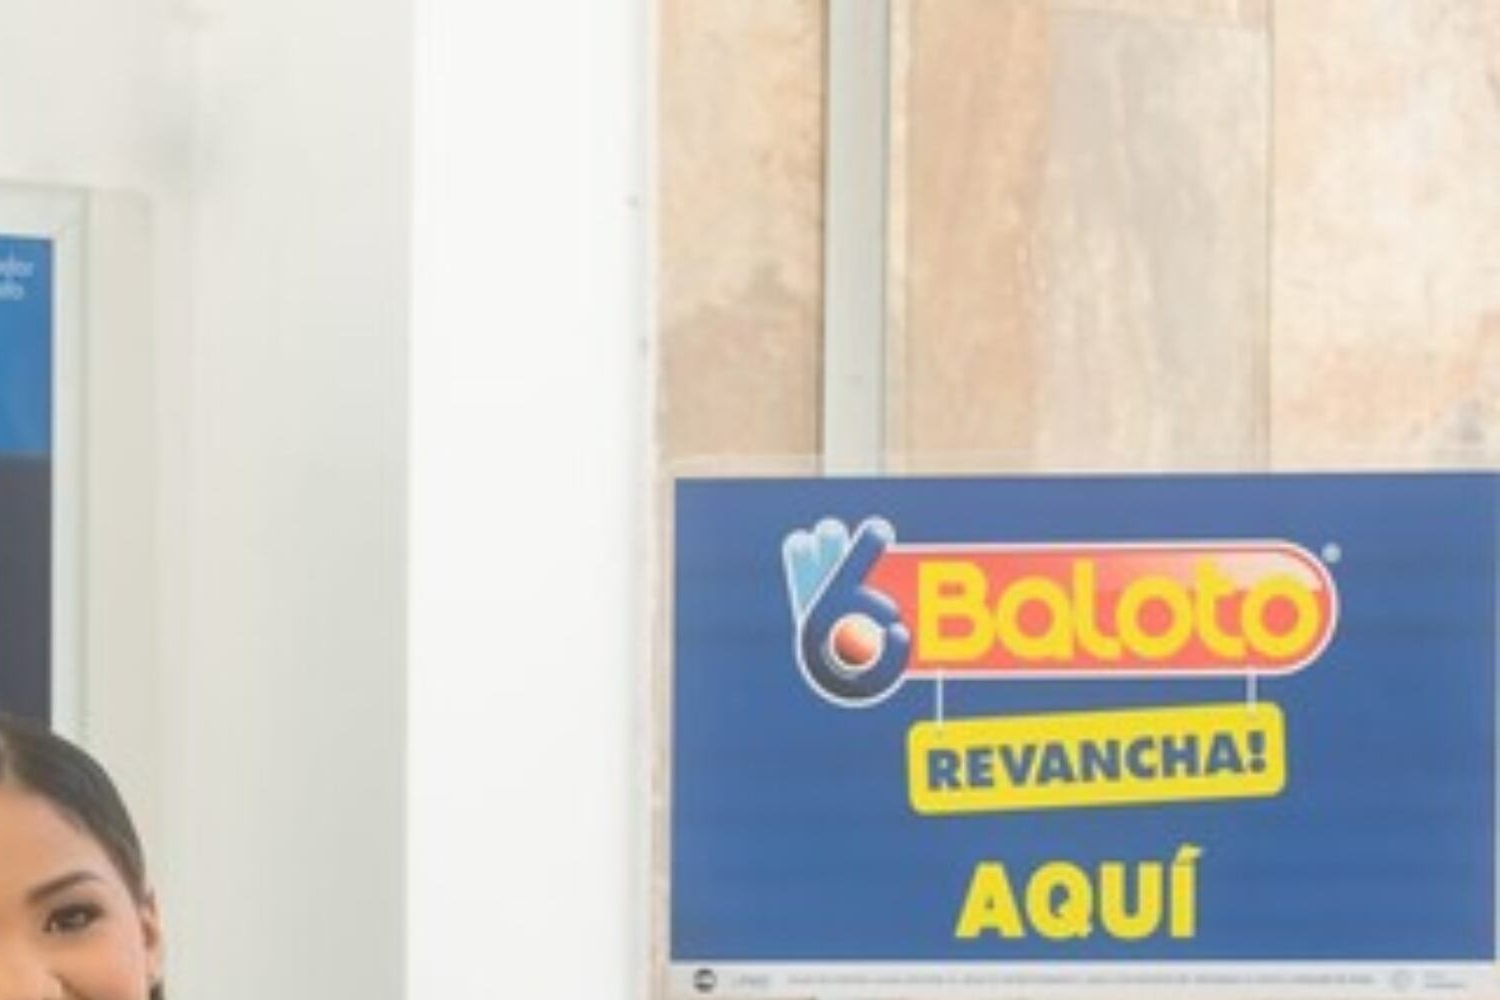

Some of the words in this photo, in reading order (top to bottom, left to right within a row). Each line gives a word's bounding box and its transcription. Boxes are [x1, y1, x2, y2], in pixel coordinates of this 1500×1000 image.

[917, 559, 1322, 661] Baloto
[926, 731, 1267, 791] REVANCHA!
[954, 844, 1202, 940] AQUÍ
